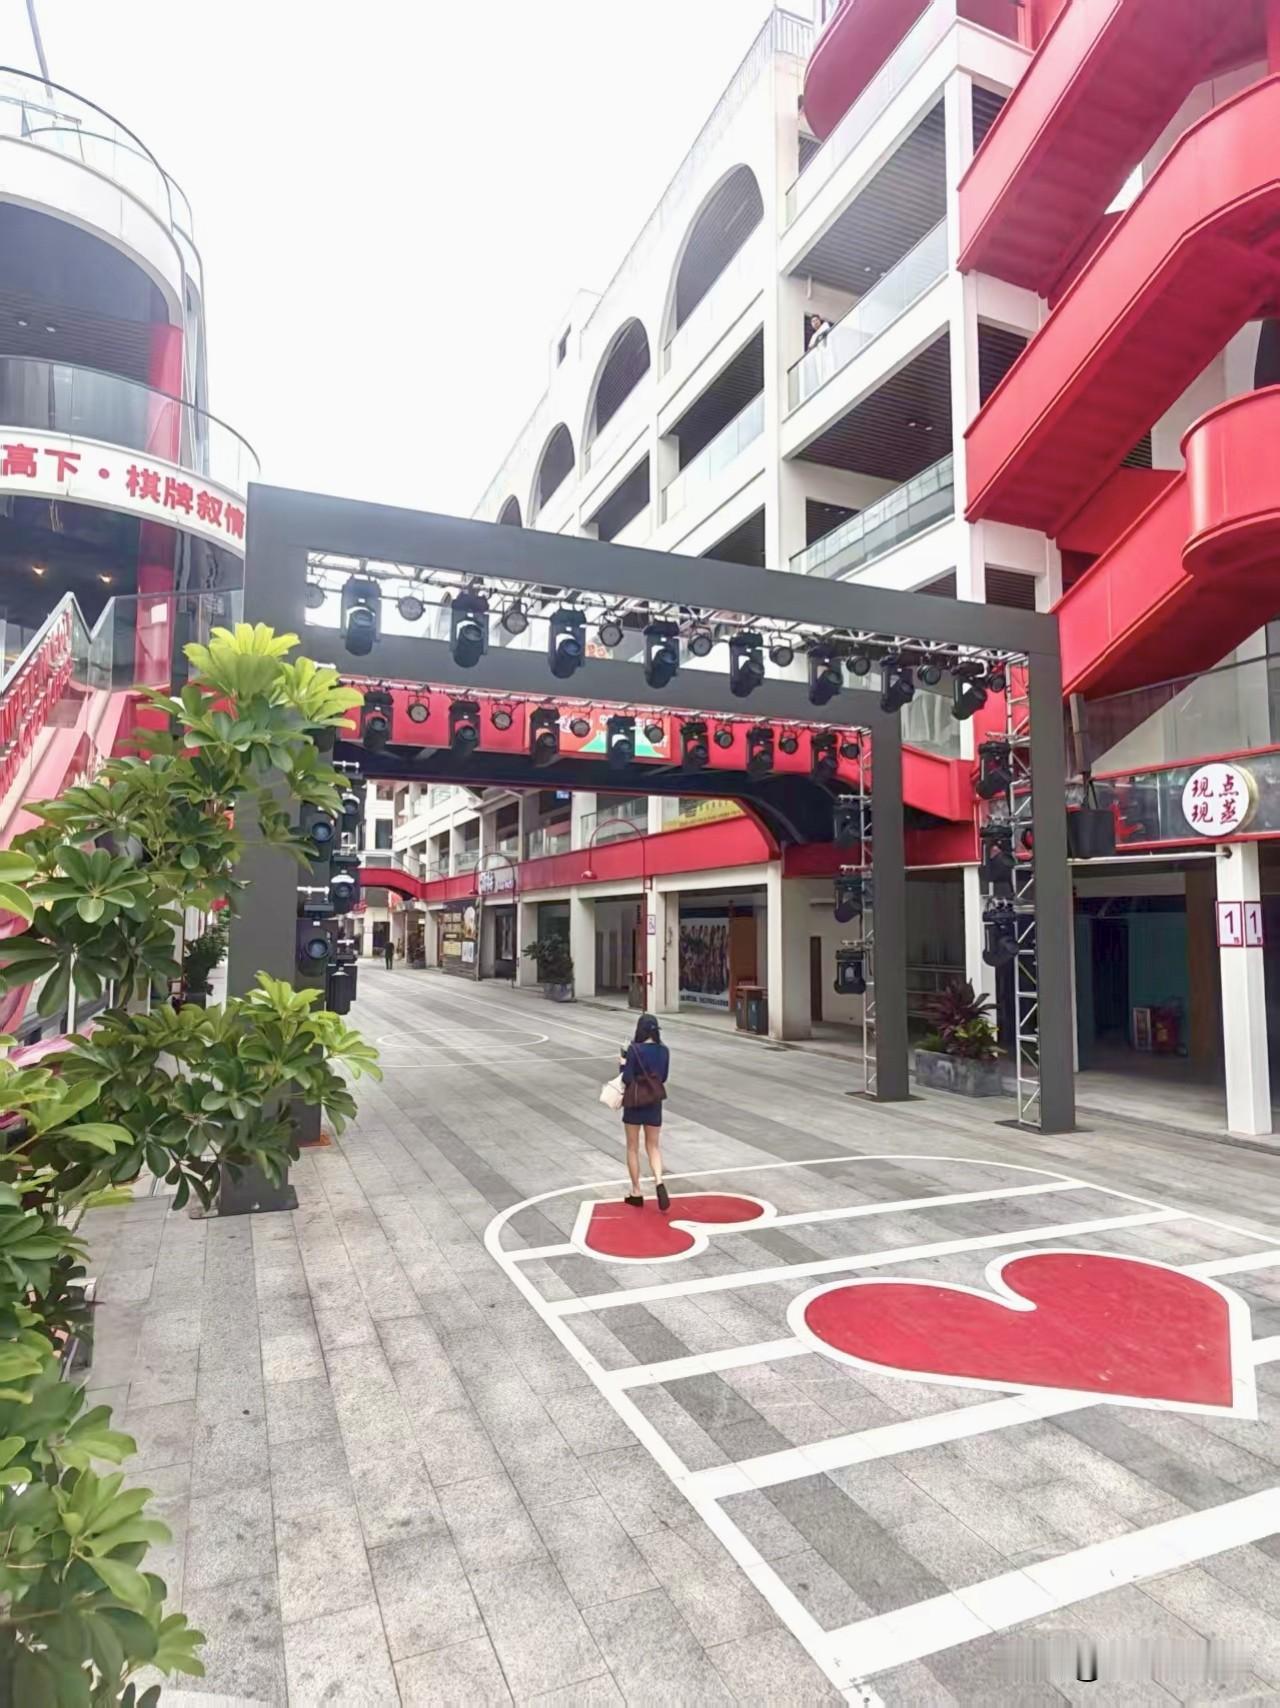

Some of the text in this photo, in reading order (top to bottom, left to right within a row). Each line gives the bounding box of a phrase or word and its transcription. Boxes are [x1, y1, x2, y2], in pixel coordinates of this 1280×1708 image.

[1192, 773, 1239, 798] 现点
[1192, 798, 1238, 825] 现蒸
[1224, 910, 1234, 935] 1
[1249, 910, 1257, 935] 1
